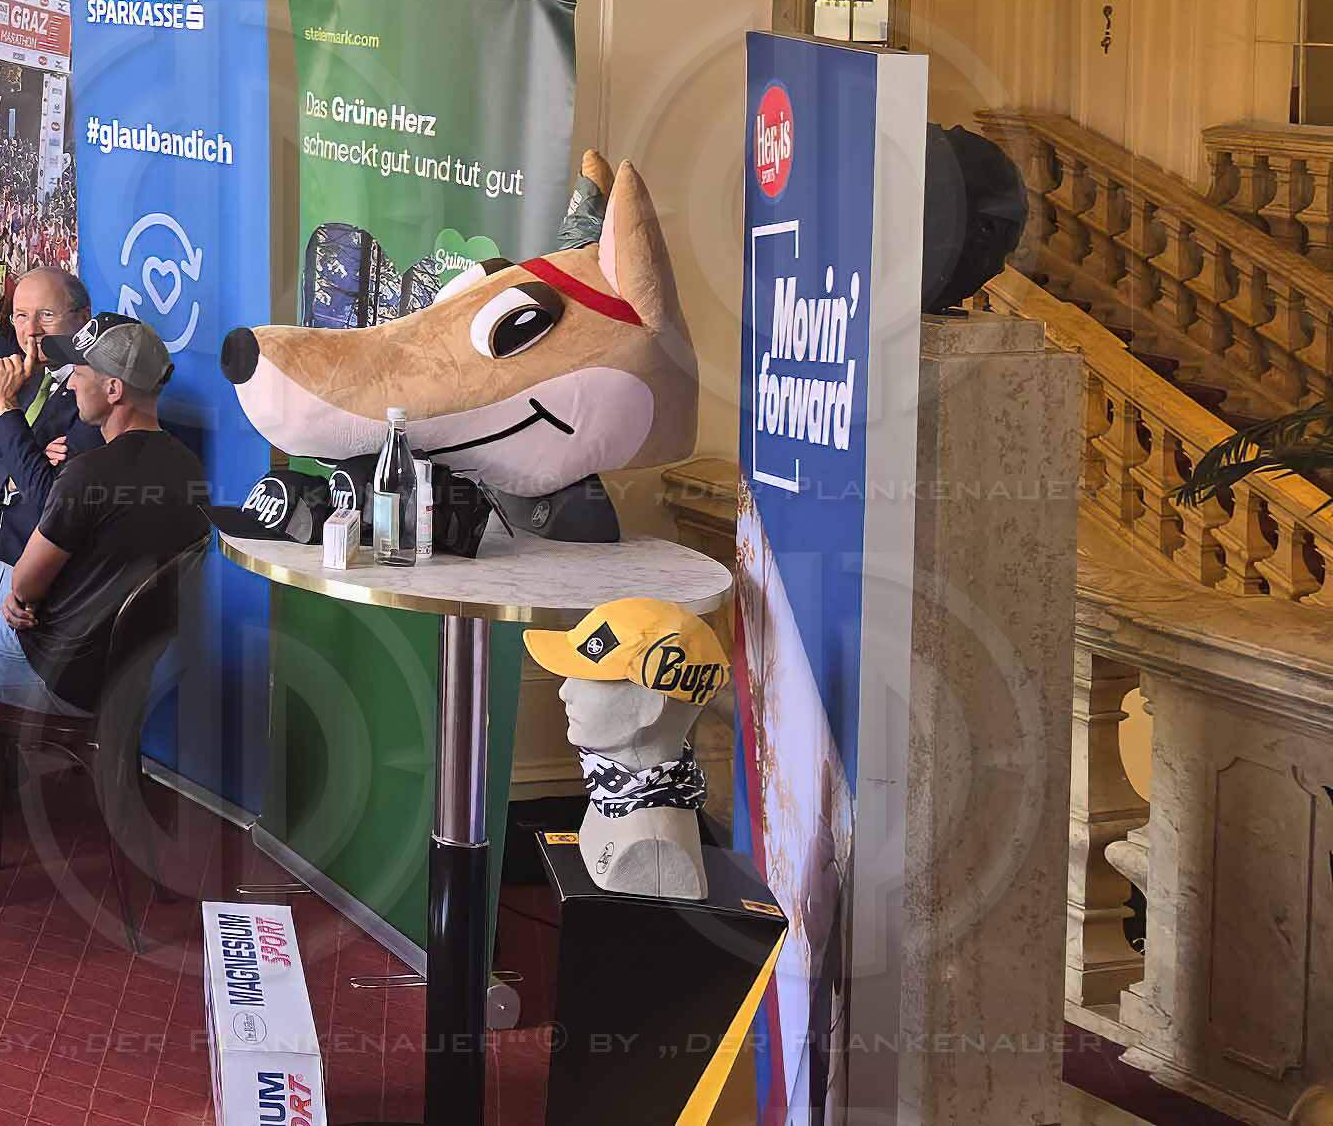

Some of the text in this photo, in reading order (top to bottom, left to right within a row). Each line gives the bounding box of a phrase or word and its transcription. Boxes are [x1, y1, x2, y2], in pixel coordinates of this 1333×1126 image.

[10, 5, 50, 36] GRAZ
[304, 26, 380, 48] steiermark.com
[86, 116, 234, 165] #glaubandich
[306, 90, 437, 137] Das Grüne Herz
[302, 132, 524, 198] schmeckt gut und tut gut
[756, 111, 792, 174] Hervis
[756, 351, 856, 451] forward
[241, 481, 286, 523] Buff
[652, 645, 721, 705] Buff
[218, 913, 265, 1007] MAGNESIUM
[255, 916, 292, 970] SPORT
